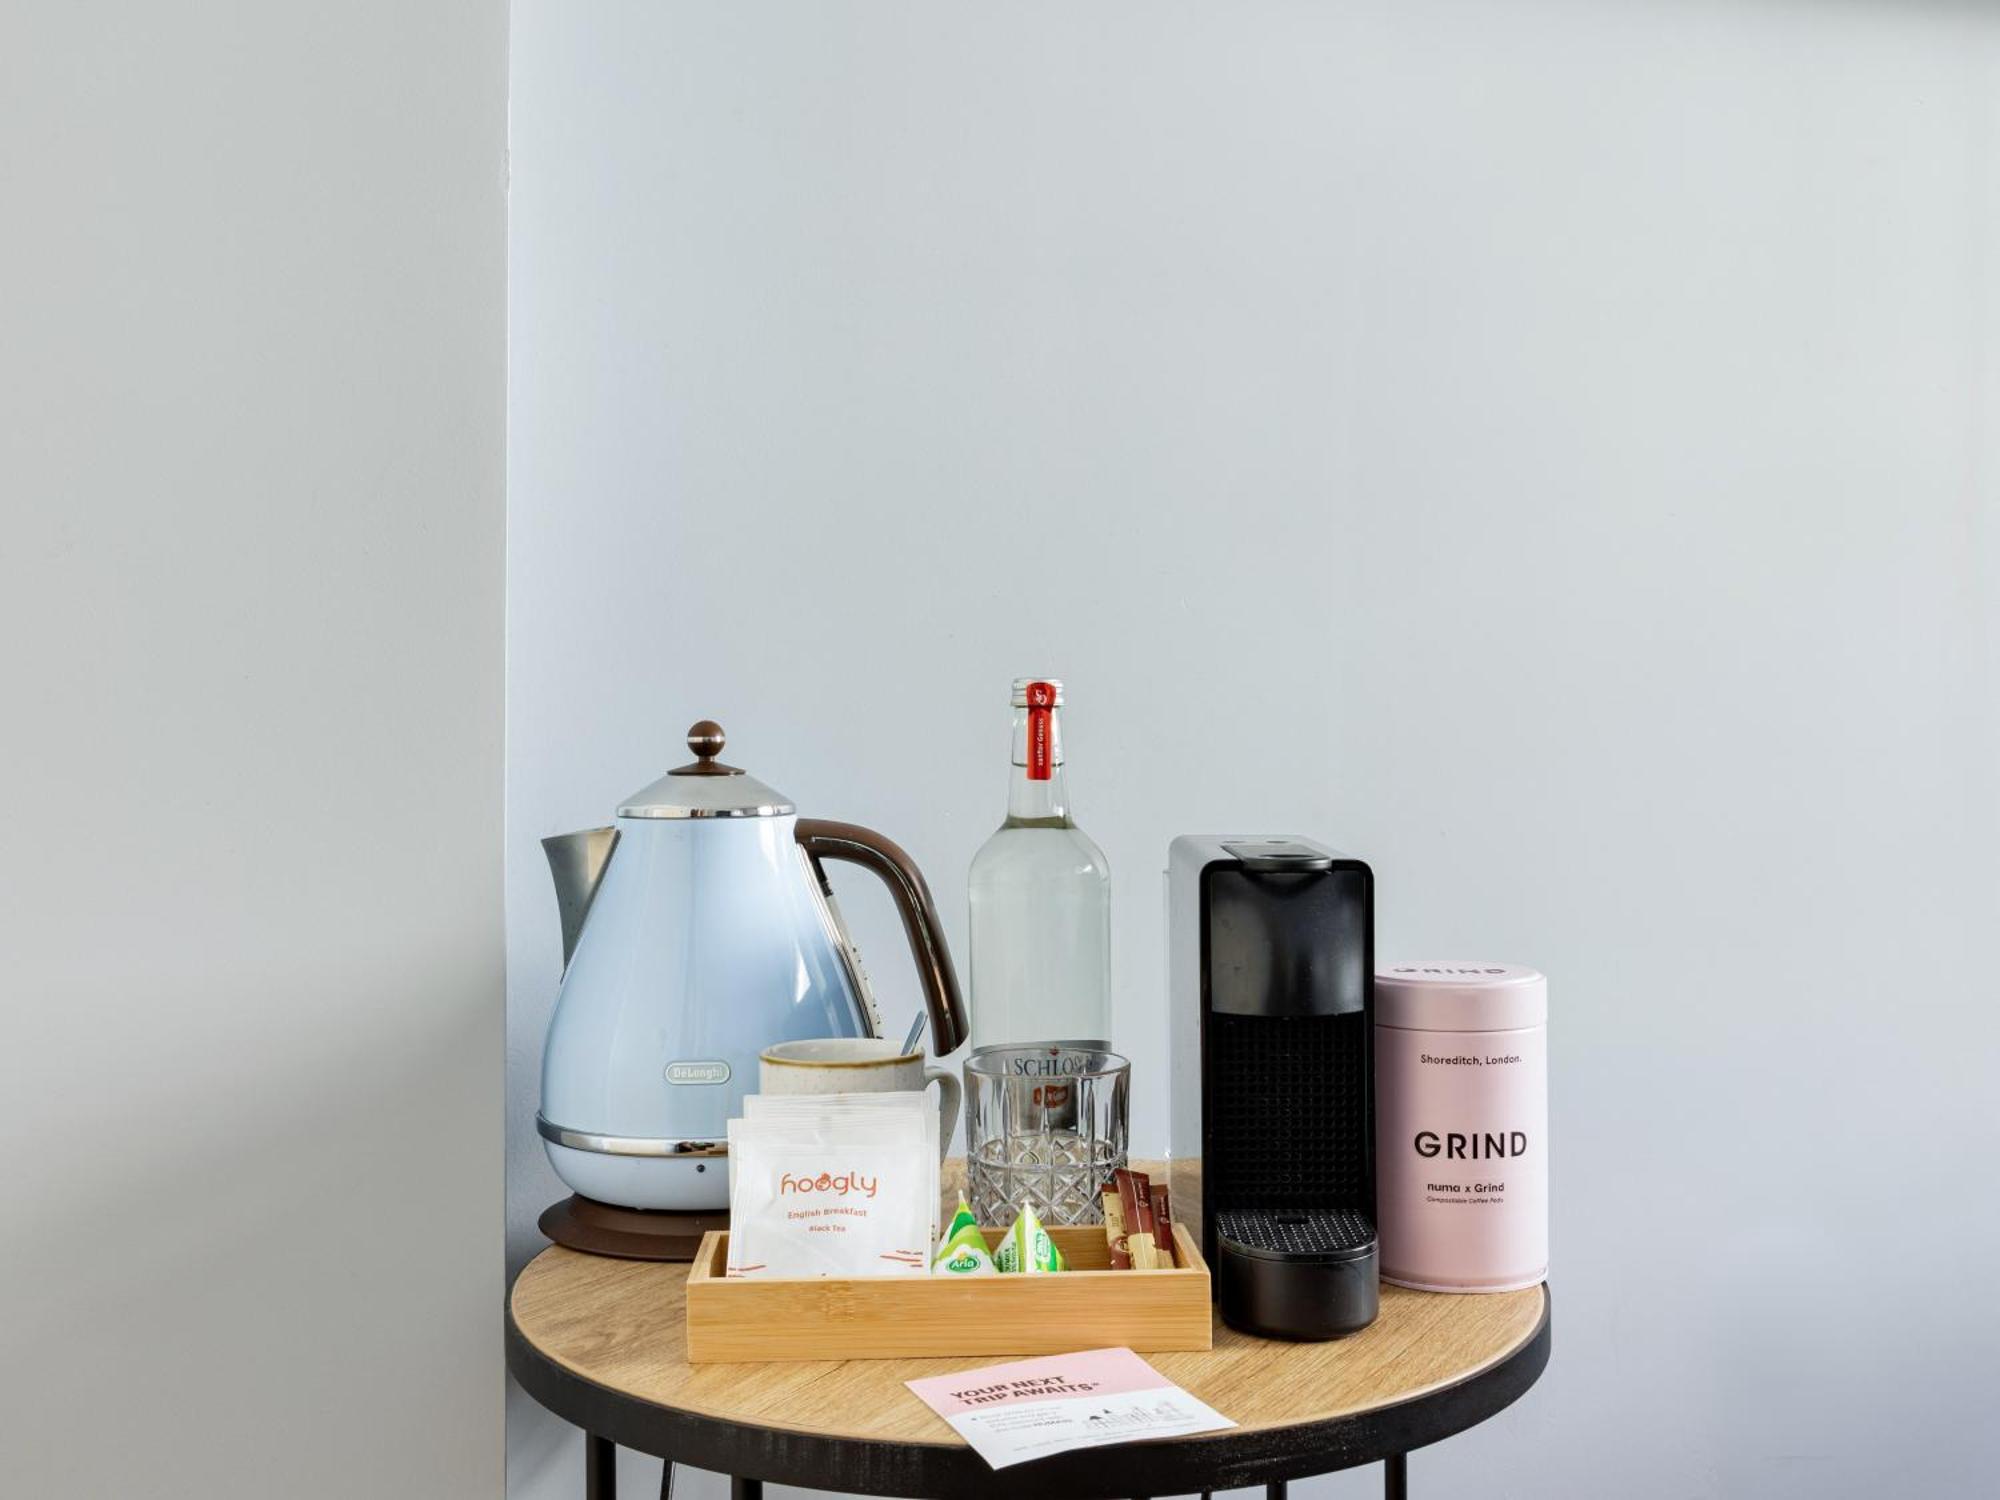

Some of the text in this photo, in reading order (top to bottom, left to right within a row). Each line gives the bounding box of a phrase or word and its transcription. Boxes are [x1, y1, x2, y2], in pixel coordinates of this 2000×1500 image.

[1392, 967, 1506, 975] GRIND
[1420, 1054, 1522, 1066] Shoreditch, London.
[1414, 1131, 1527, 1159] GRIND
[781, 1171, 877, 1198] hoogly
[1427, 1183, 1460, 1192] numa
[1474, 1182, 1504, 1193] Grind
[788, 1207, 867, 1220] English Breakfast
[809, 1224, 846, 1232] Black Tea
[951, 1258, 975, 1269] Arla
[950, 1375, 1066, 1399] YOUR NEXT
[959, 1393, 1008, 1405] TRIP
